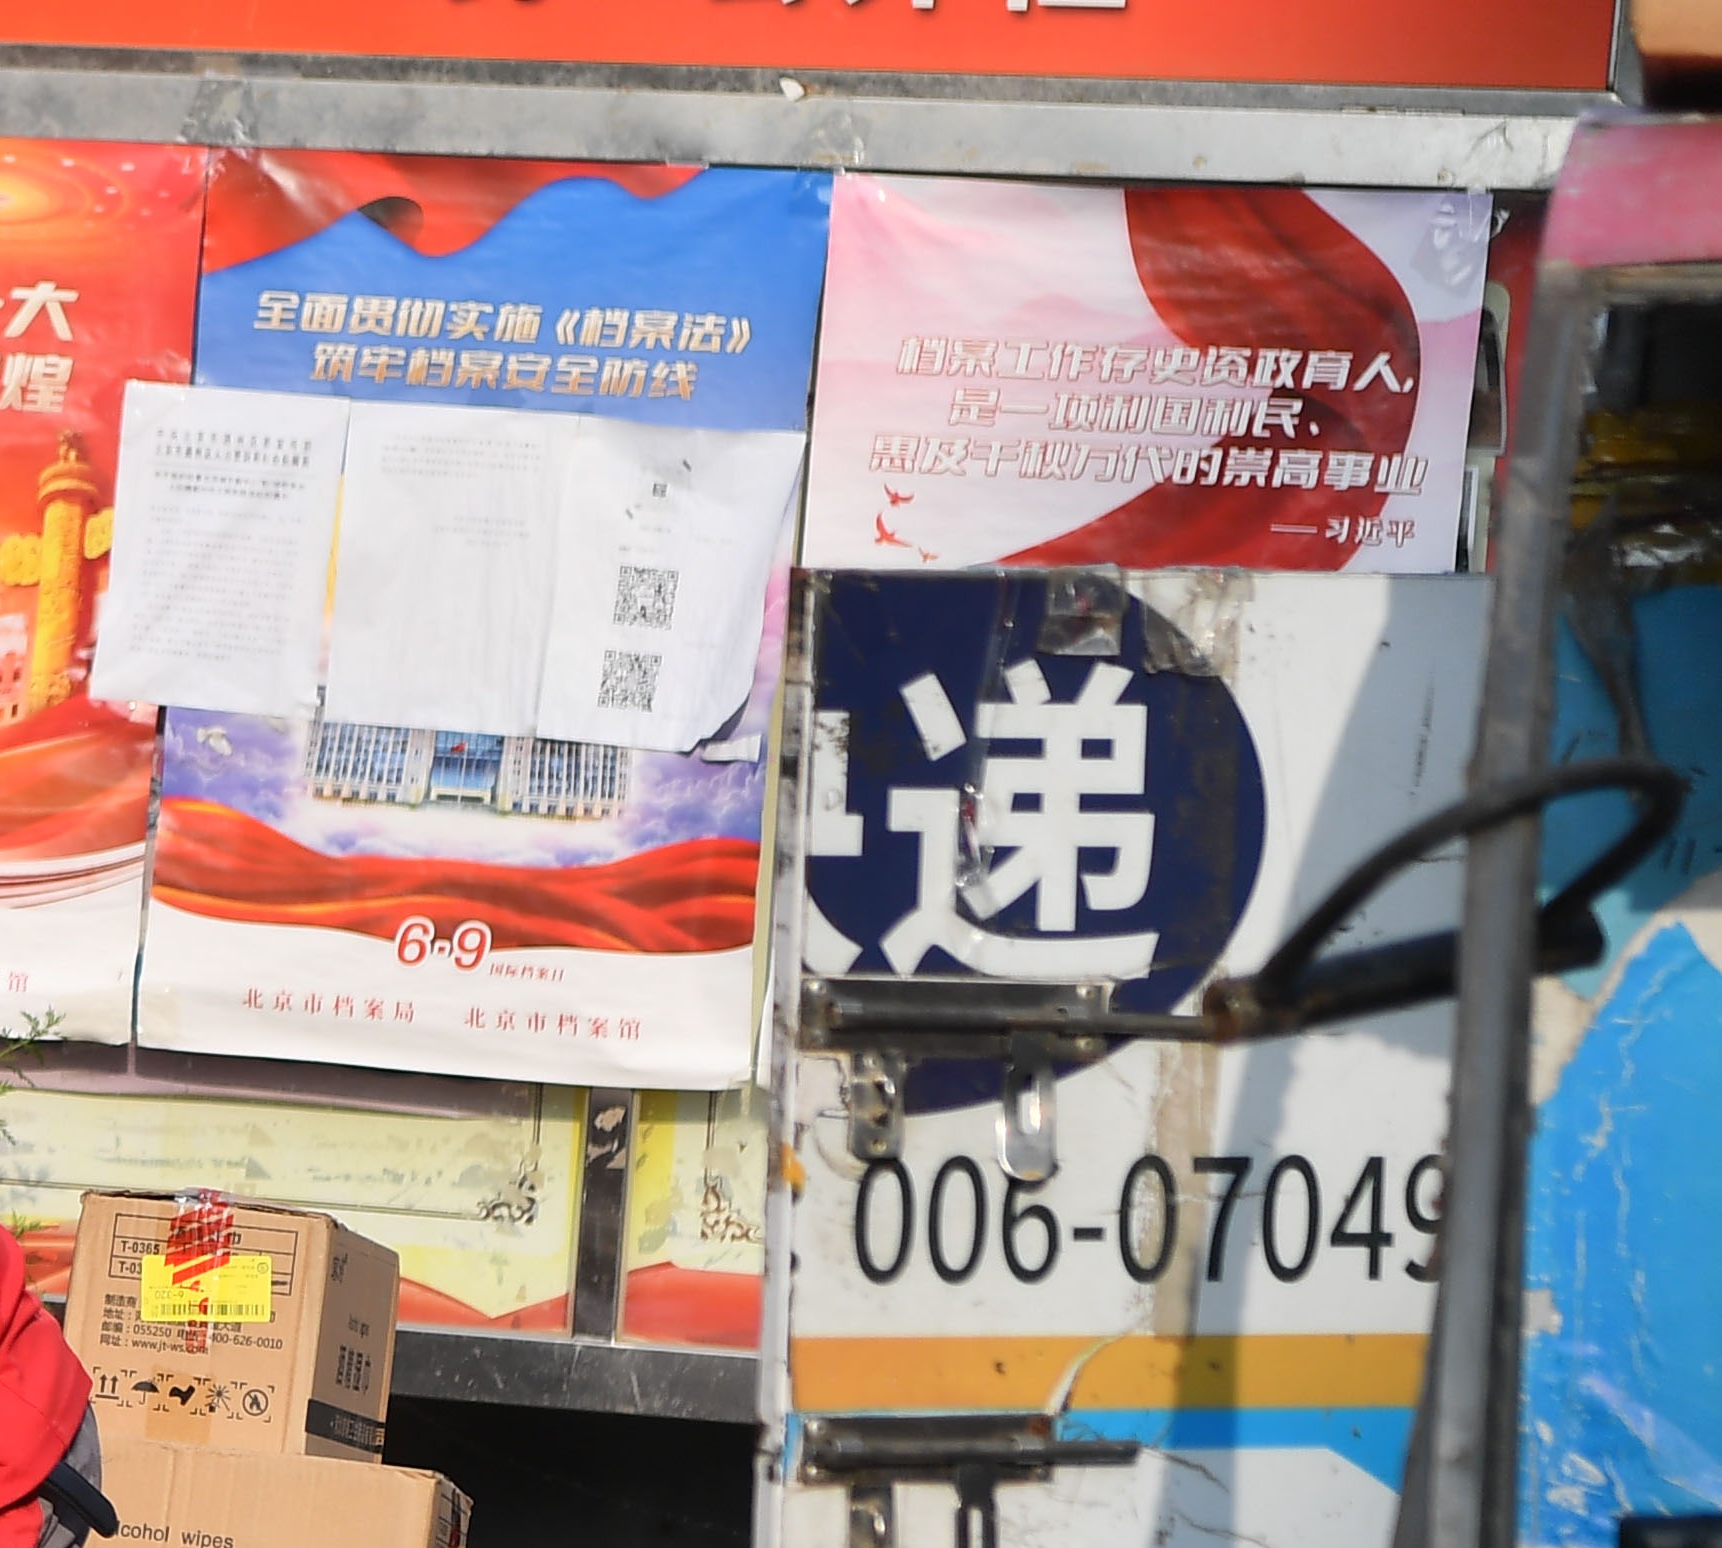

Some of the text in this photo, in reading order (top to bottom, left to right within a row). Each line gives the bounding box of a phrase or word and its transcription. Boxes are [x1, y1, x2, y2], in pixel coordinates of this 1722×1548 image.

[253, 288, 753, 355] 全面贯彻实施《档案法》
[309, 342, 699, 400] 筑牢档案安全防线
[868, 434, 1429, 496] 惠及千秋万代的崇高事业
[242, 987, 643, 1041] 北京市档案局 北京市档案馆
[121, 1240, 160, 1255] T-0365
[116, 1520, 171, 1543] lcohol
